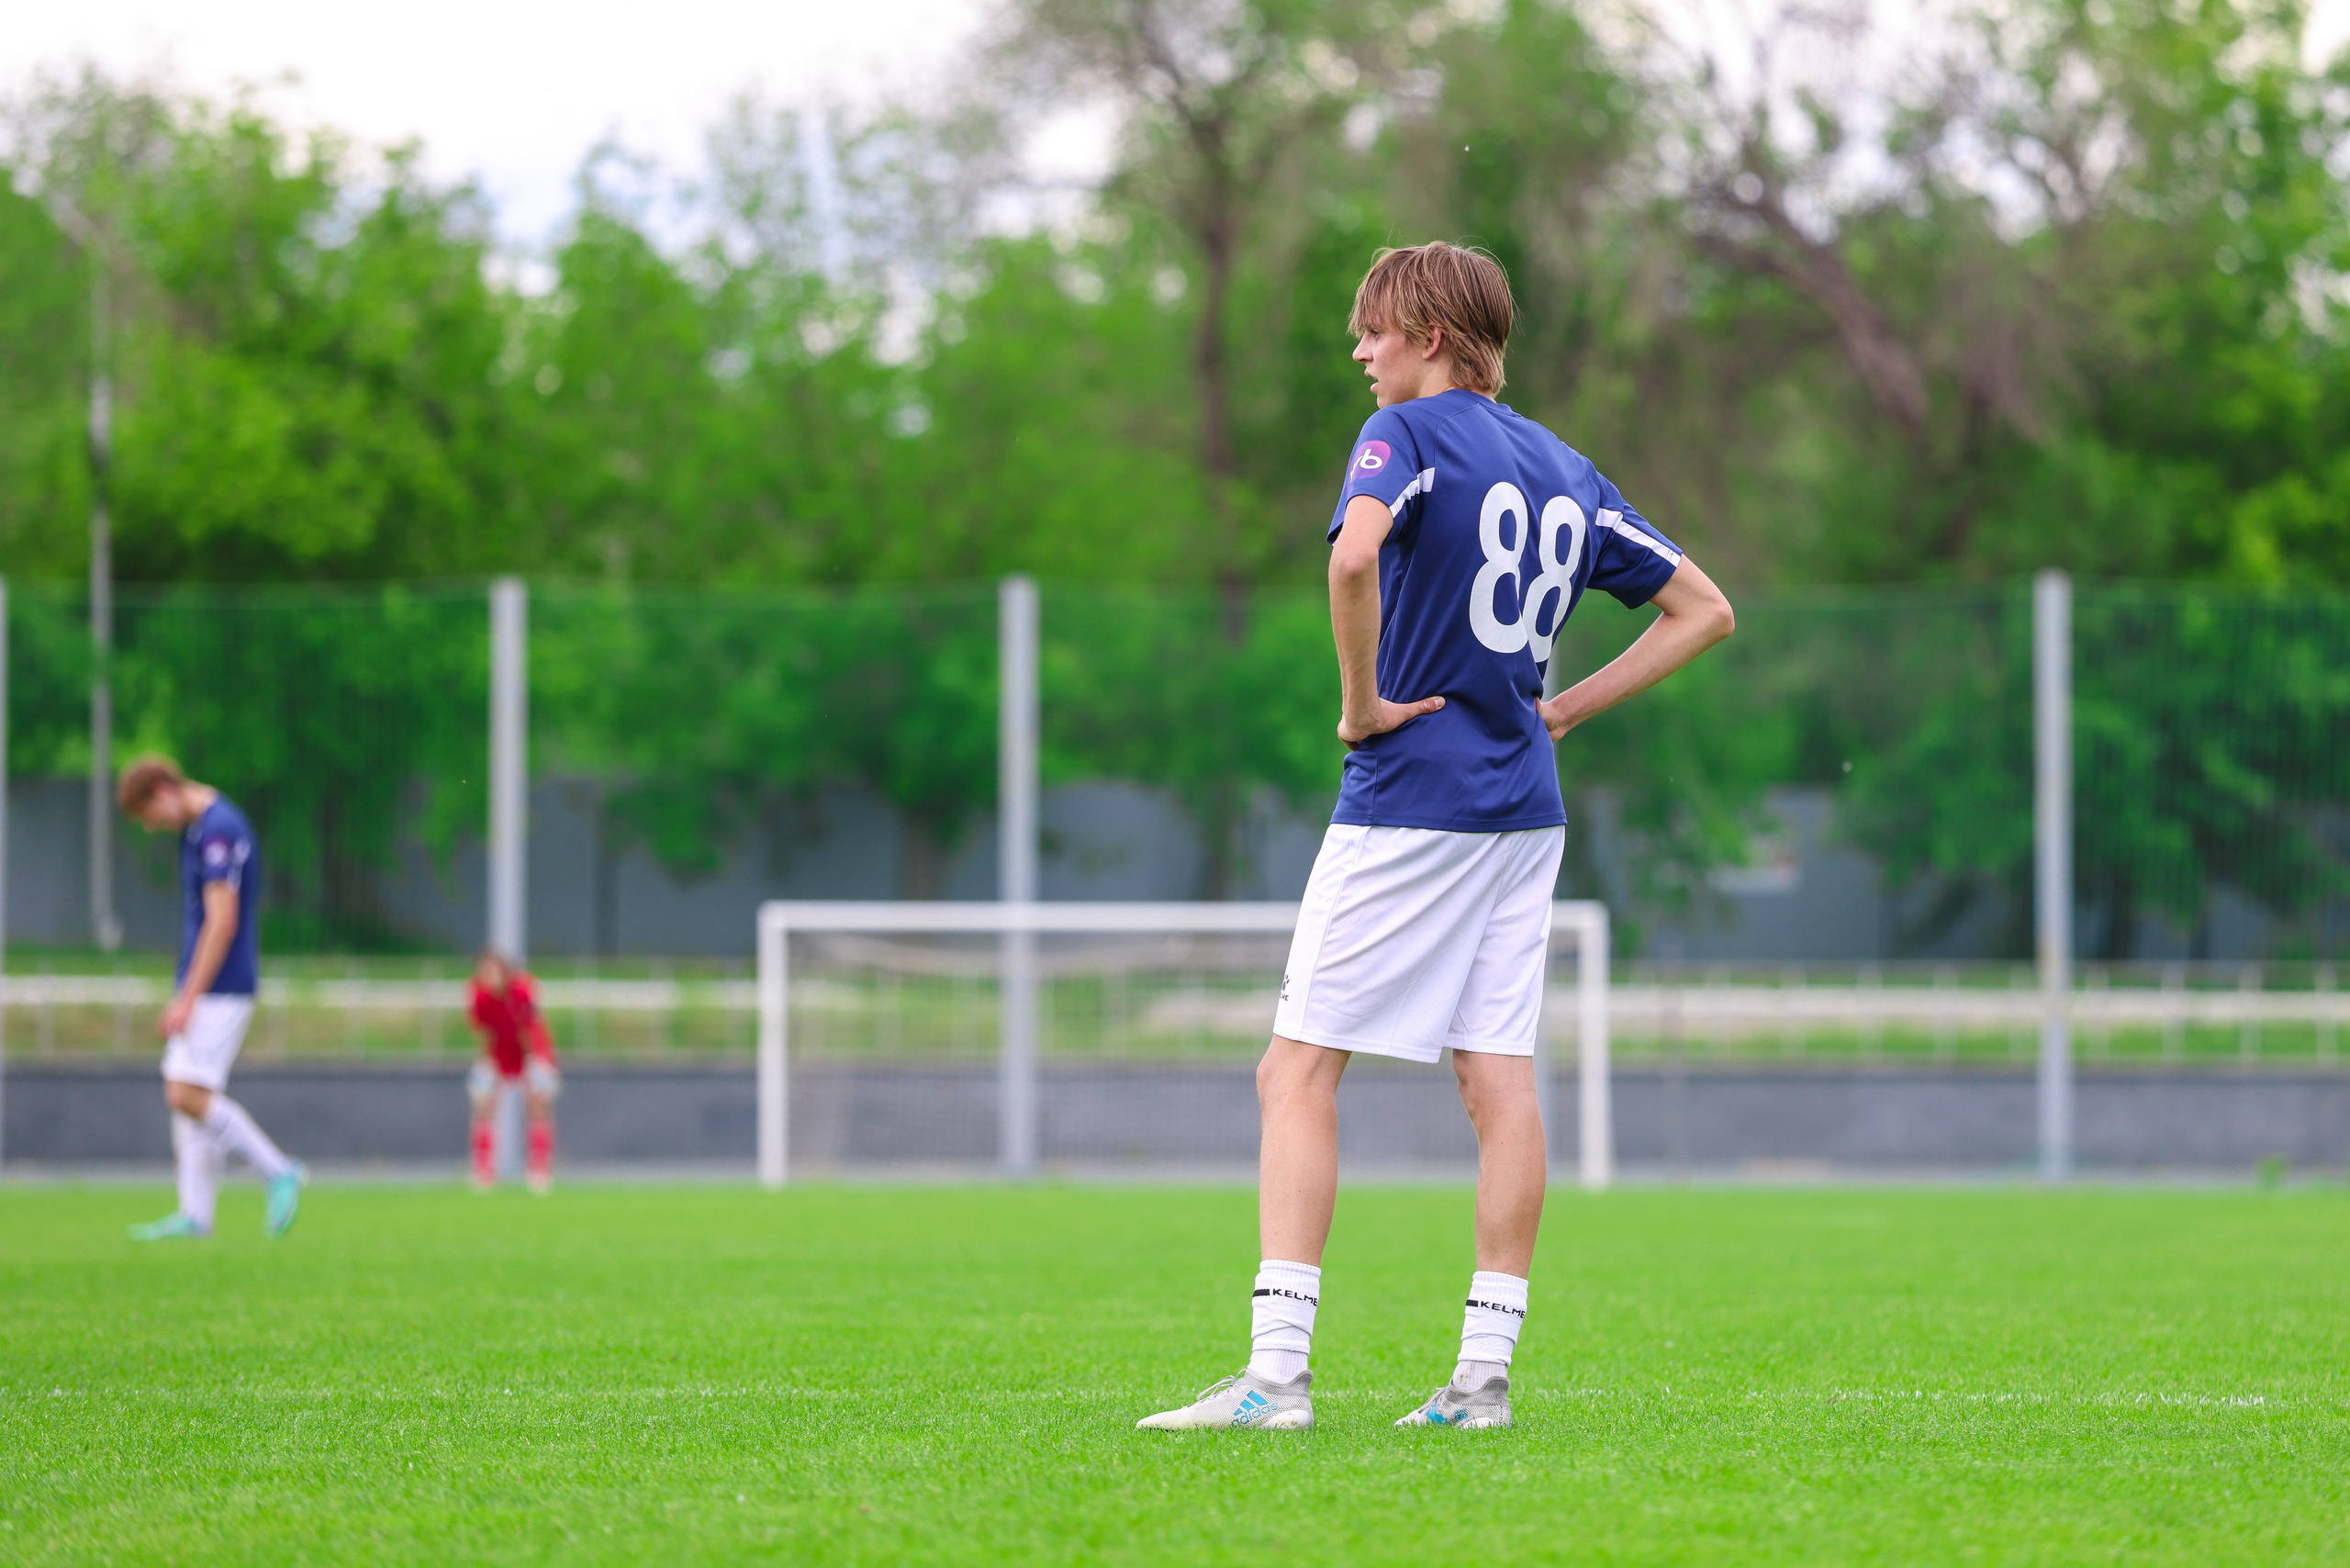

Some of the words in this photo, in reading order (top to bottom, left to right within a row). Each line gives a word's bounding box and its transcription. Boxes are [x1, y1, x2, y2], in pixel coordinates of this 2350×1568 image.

[1469, 481, 1586, 663] 88
[1272, 1288, 1318, 1307] KELME
[1231, 1403, 1279, 1428] adidas
